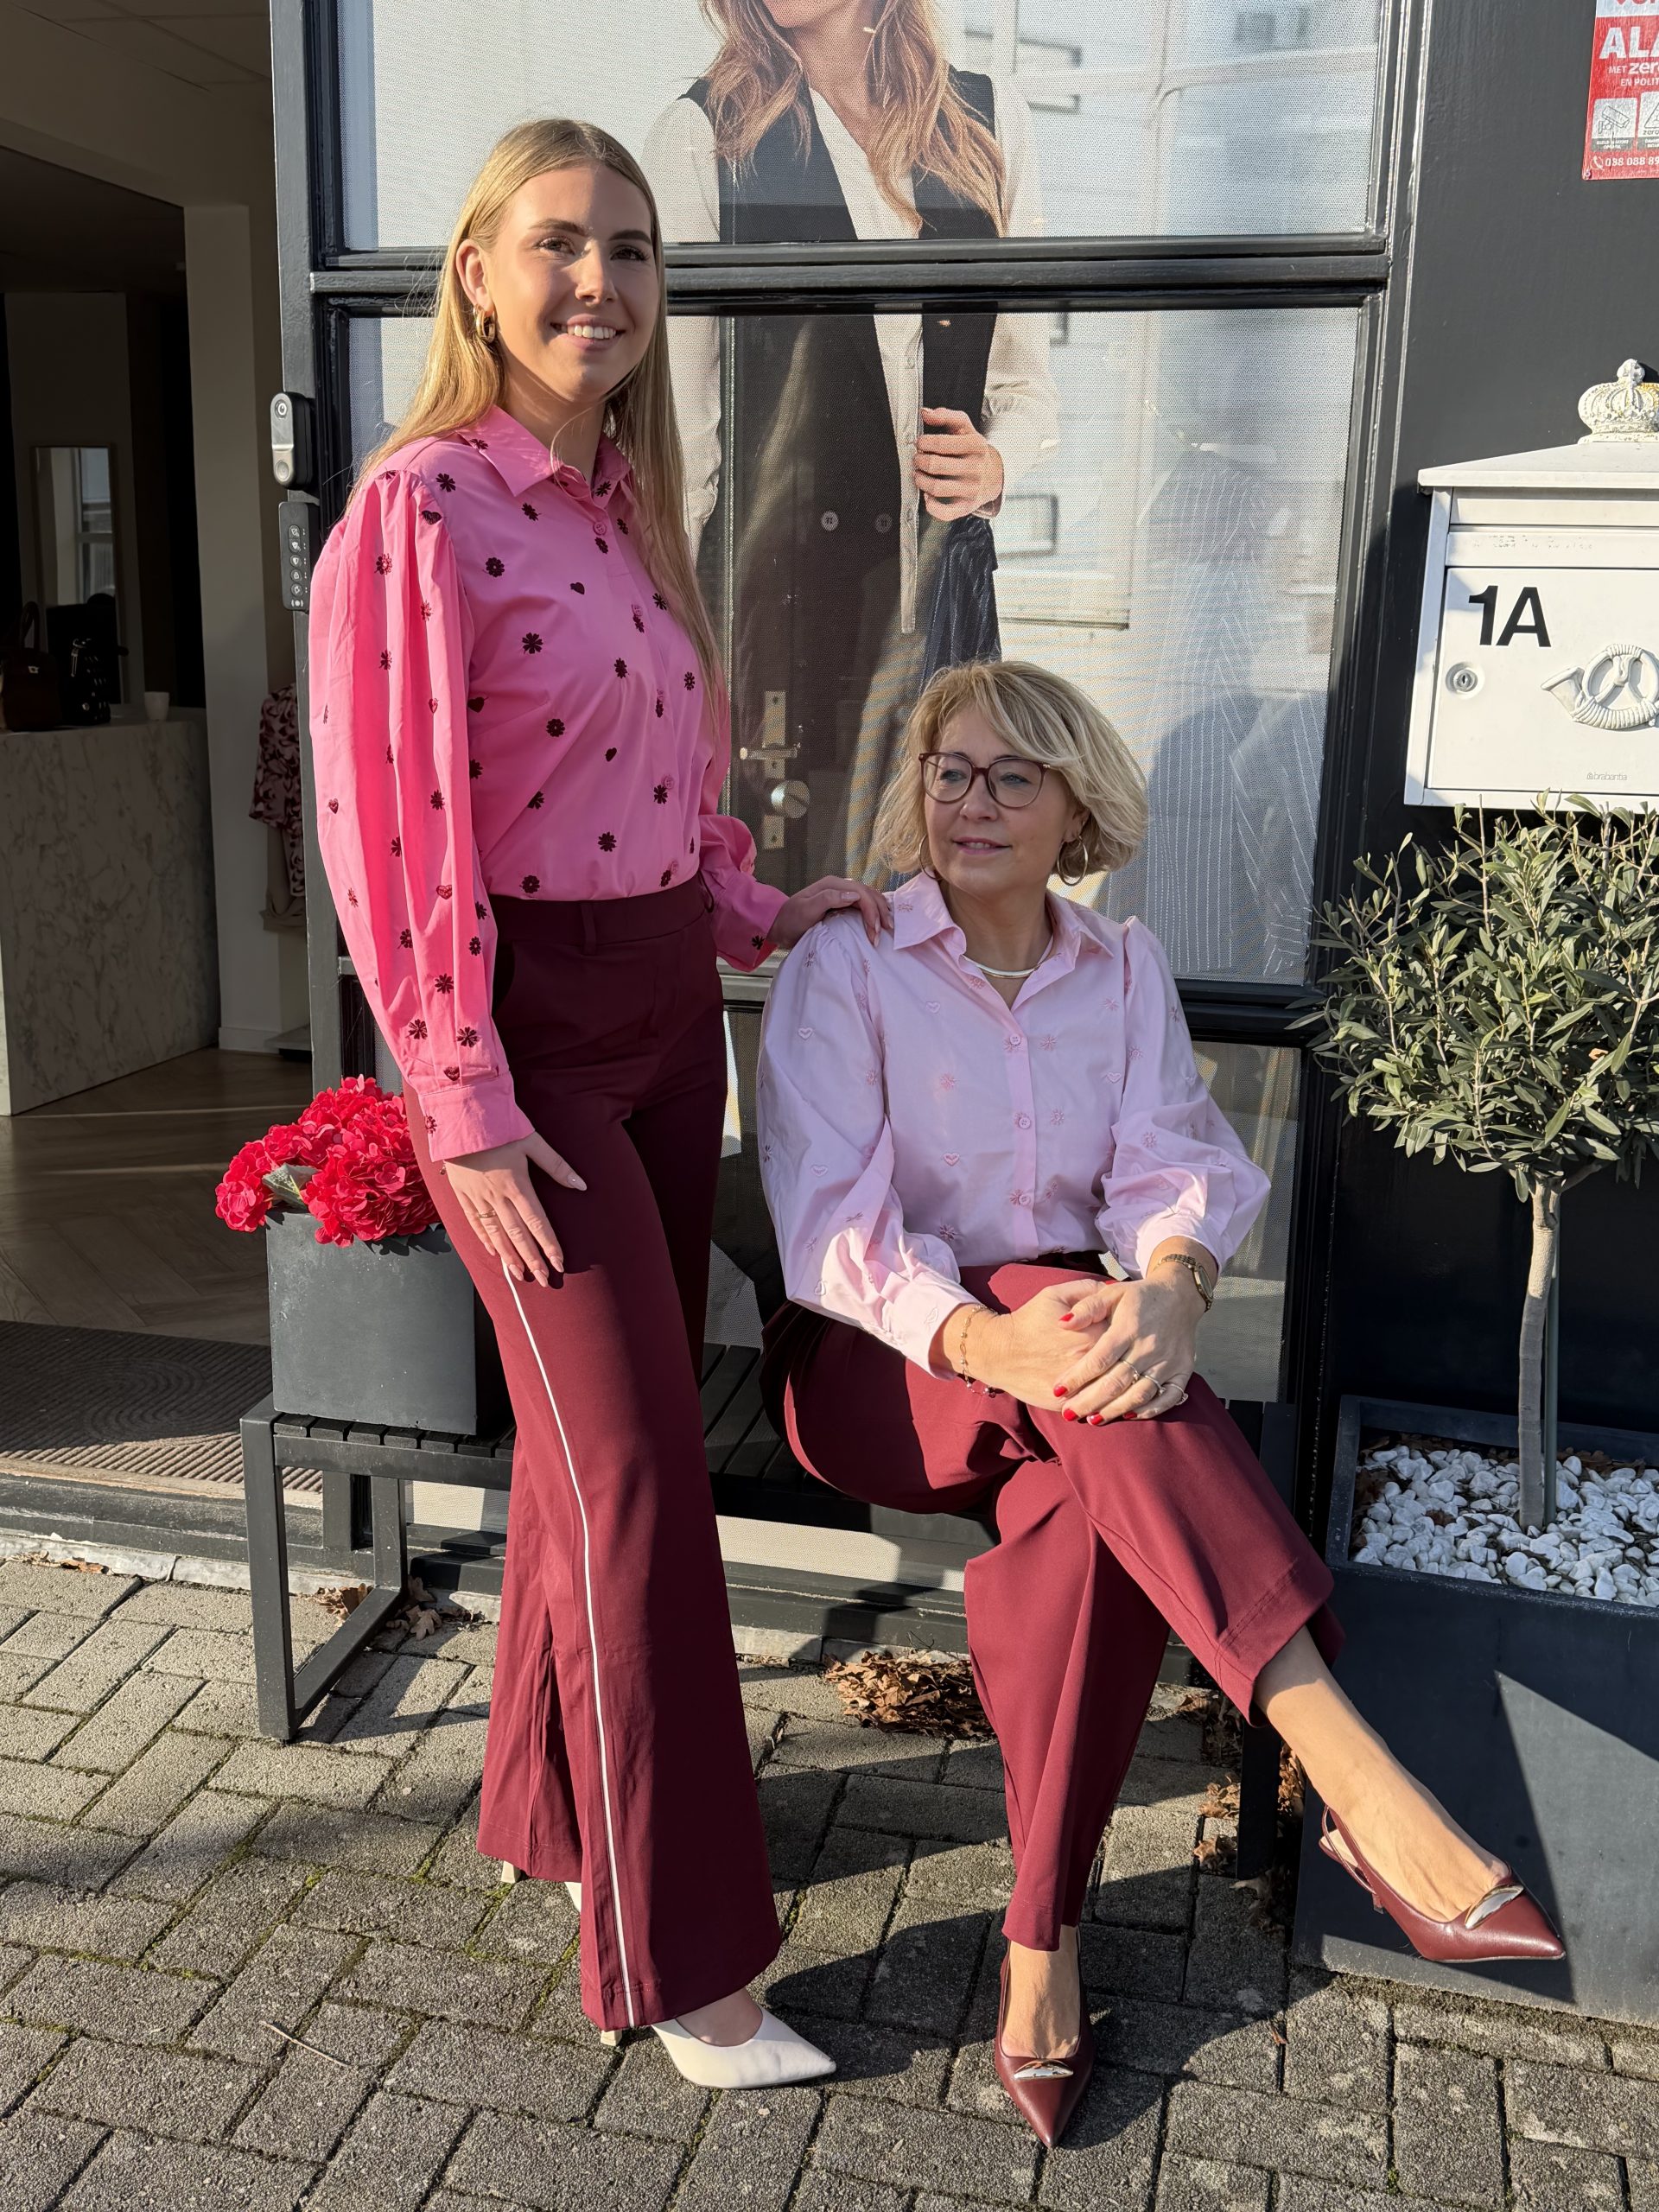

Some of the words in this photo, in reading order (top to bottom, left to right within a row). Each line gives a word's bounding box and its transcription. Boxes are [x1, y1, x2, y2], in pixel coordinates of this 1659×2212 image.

[1628, 62, 1659, 75] zer
[1620, 78, 1632, 86] EN
[1605, 157, 1624, 166] 088
[1627, 156, 1646, 166] 088
[1469, 585, 1551, 647] 1A
